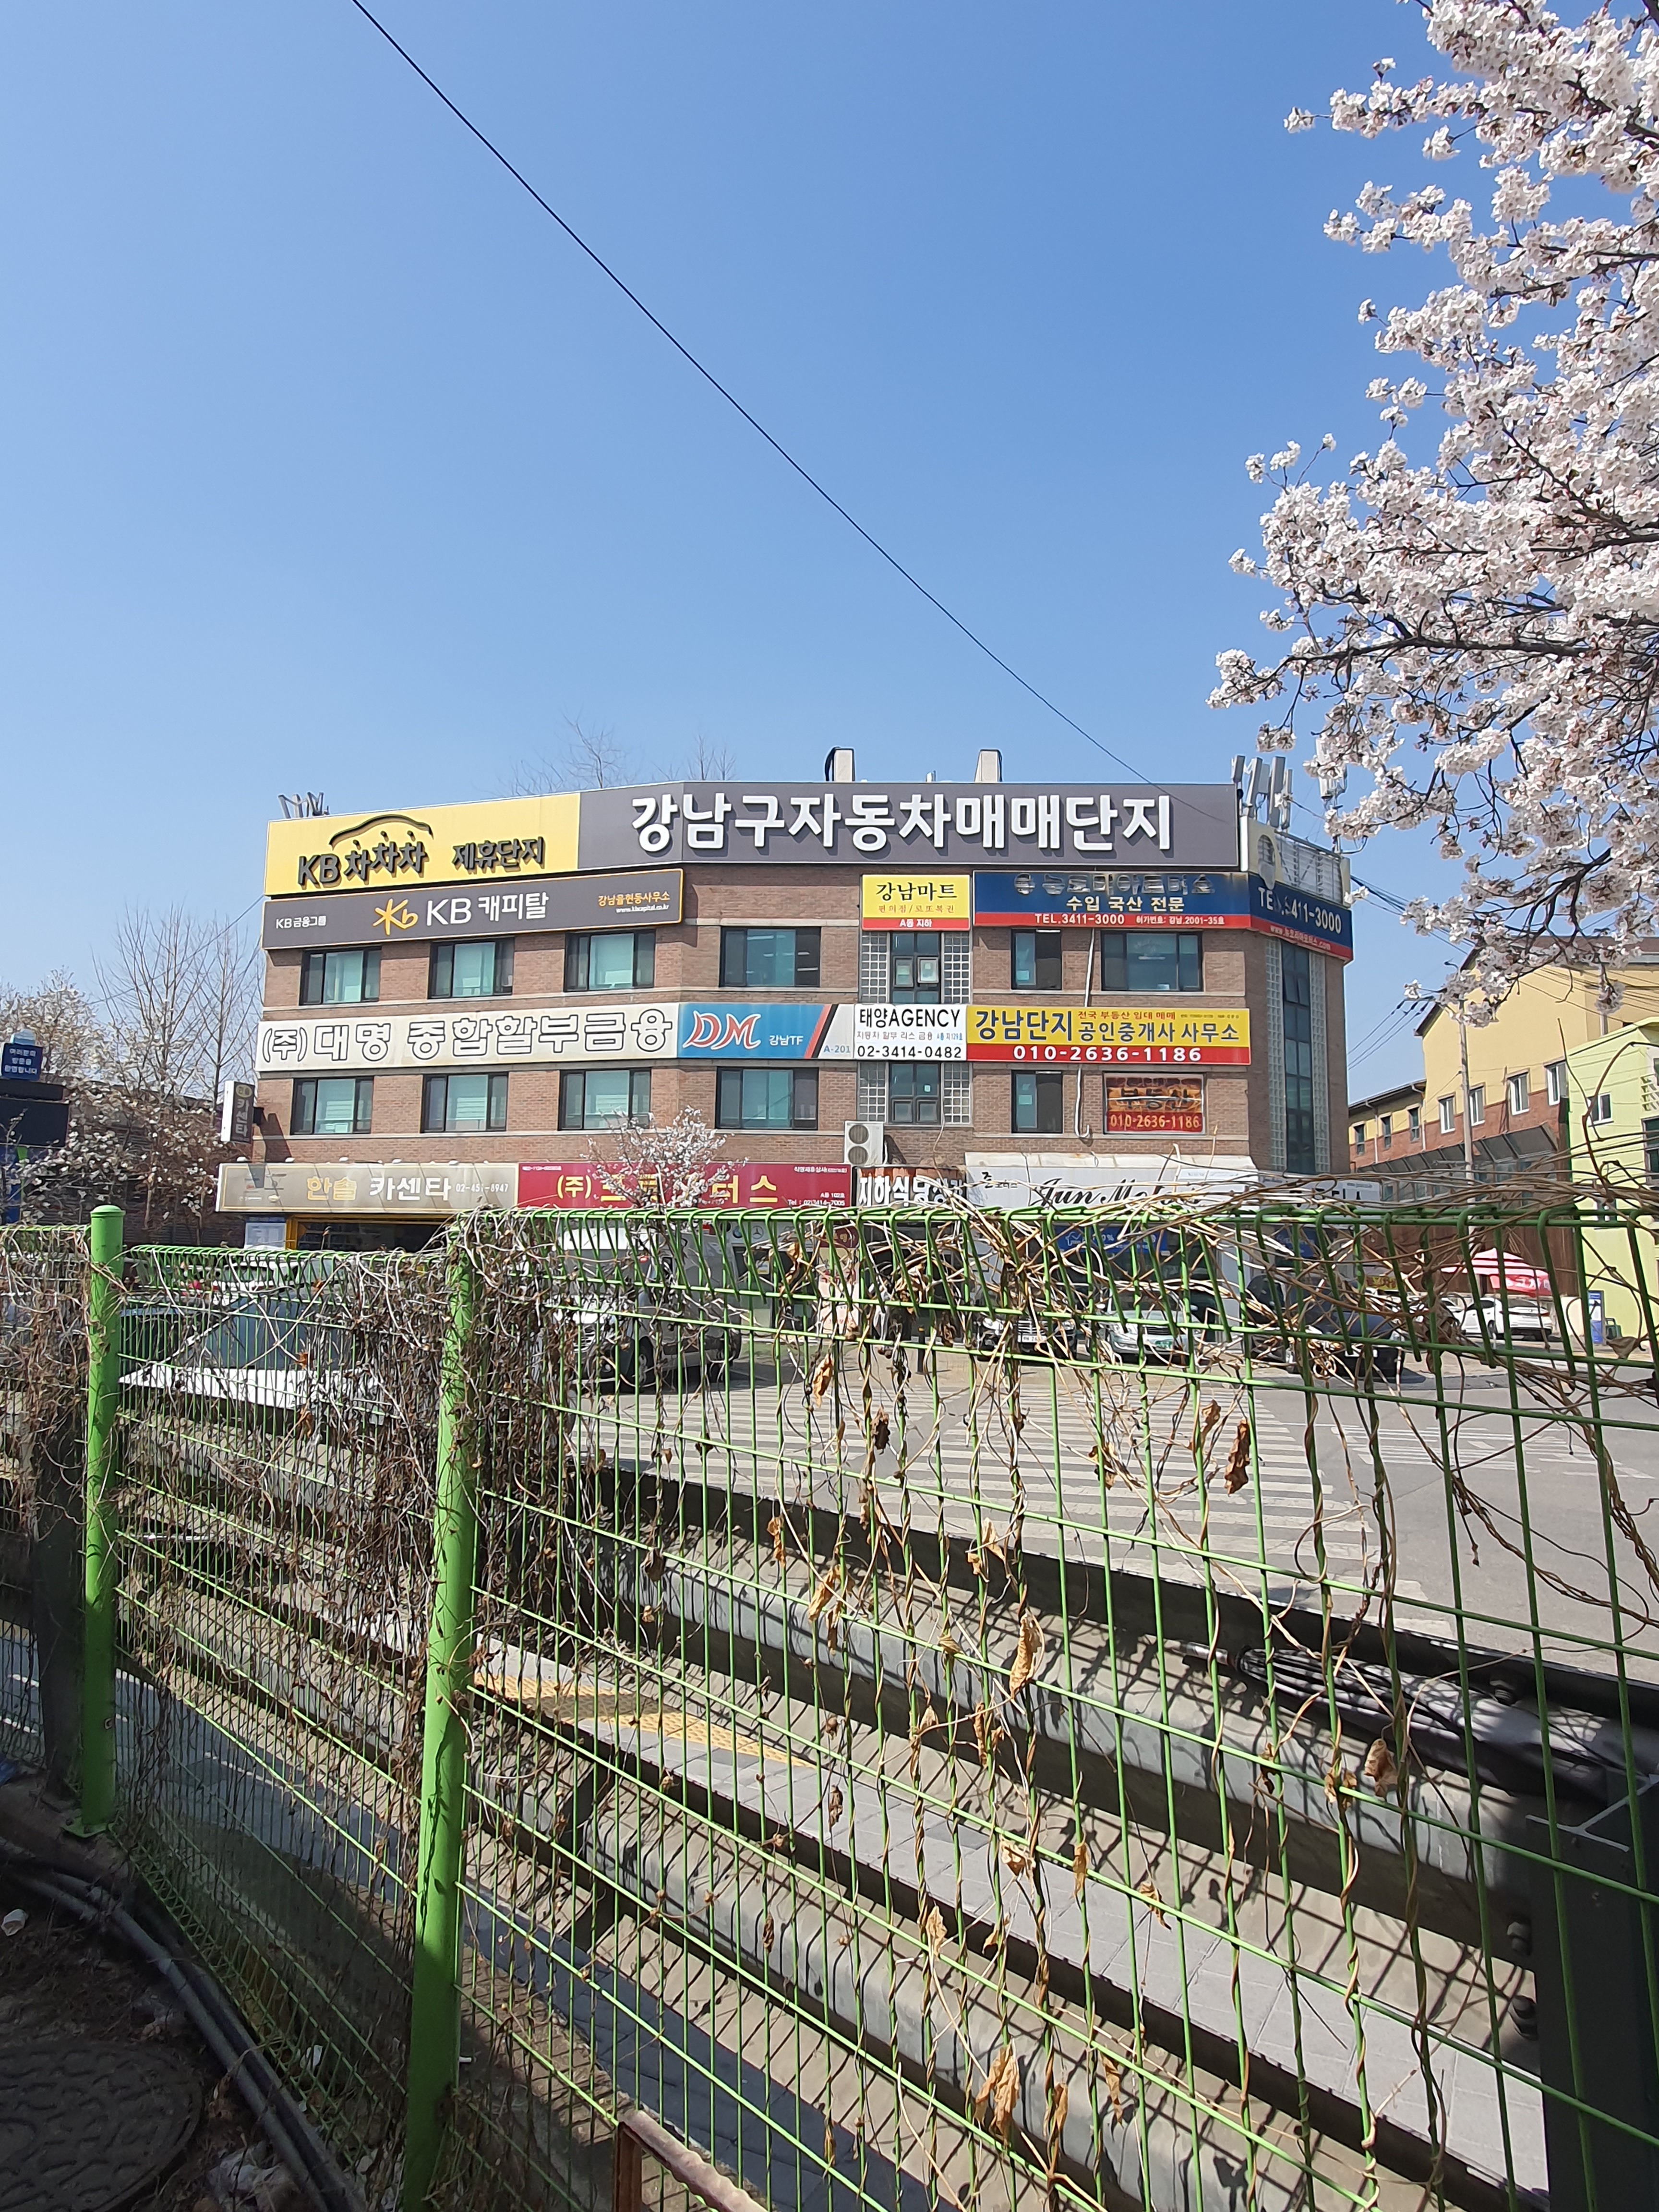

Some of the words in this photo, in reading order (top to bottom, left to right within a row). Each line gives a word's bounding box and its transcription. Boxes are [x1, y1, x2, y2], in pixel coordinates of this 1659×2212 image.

[632, 793, 1170, 852] 강남구자동차매매단지
[452, 836, 544, 870] 제휴단지
[876, 882, 957, 901] 강남마트
[1066, 896, 1099, 911] 수입
[1108, 896, 1142, 912] 국산
[1151, 896, 1184, 912] 전문
[916, 919, 932, 927] 지하
[1034, 914, 1124, 924] TEL.3411-3000
[860, 1008, 961, 1028] 태양AGENCY
[1101, 1011, 1130, 1020] 부동산
[1134, 1011, 1153, 1020] 임대
[1156, 1012, 1175, 1020] 매매
[976, 1010, 1071, 1041] 강남단지
[1078, 1022, 1175, 1042] 공인중개사
[1181, 1022, 1239, 1043] 사무소
[408, 1009, 672, 1060] 종합할부금융
[769, 1035, 804, 1046] 강남TF
[823, 1045, 851, 1053] A-201
[858, 1046, 961, 1058] 02-3414-0482
[1014, 1046, 1201, 1061] 010-2636-1186
[1110, 1114, 1199, 1128] 010-2636-1186
[307, 1176, 357, 1201] 한솔
[370, 1177, 451, 1201] 카센타
[557, 1175, 591, 1199] (주)
